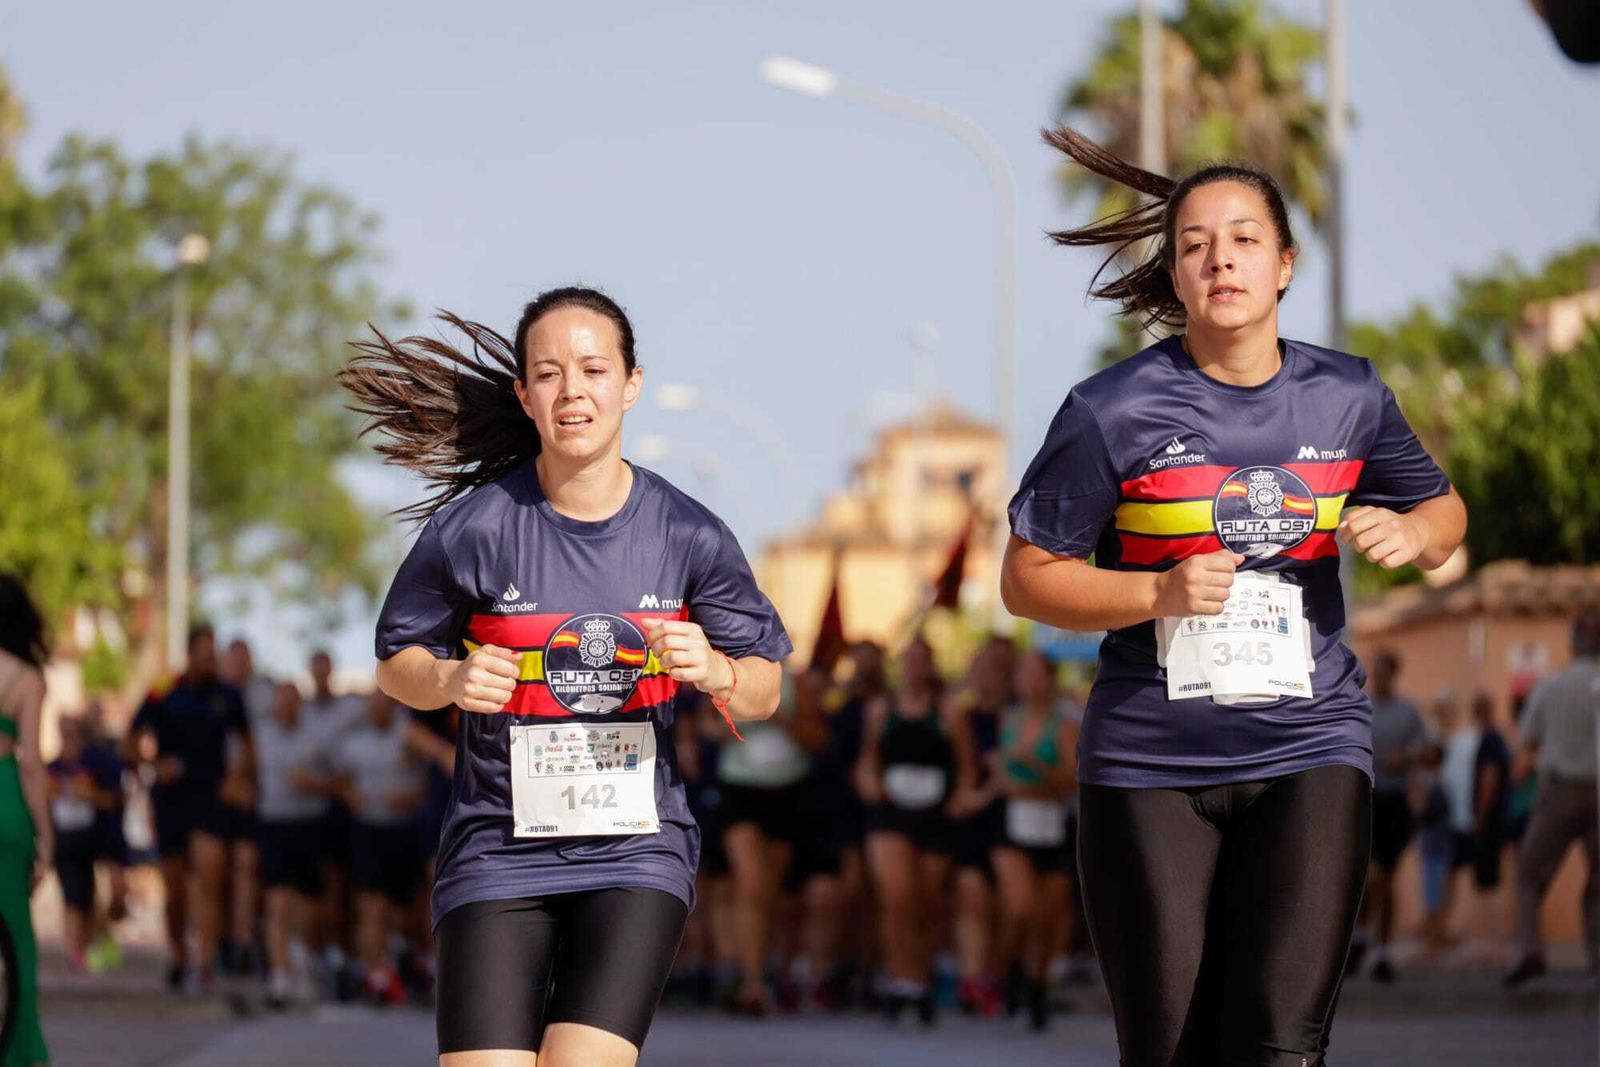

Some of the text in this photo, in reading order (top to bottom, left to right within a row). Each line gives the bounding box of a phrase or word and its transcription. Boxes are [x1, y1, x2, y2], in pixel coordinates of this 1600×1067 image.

[1149, 453, 1206, 470] Santander
[1221, 520, 1310, 533] RUTA 091
[661, 598, 684, 610] mu
[1213, 642, 1273, 667] 345
[550, 671, 600, 683] RUTA
[1178, 681, 1212, 692] #RUTA091
[561, 784, 618, 810] 142
[524, 825, 559, 833] #RUTA091
